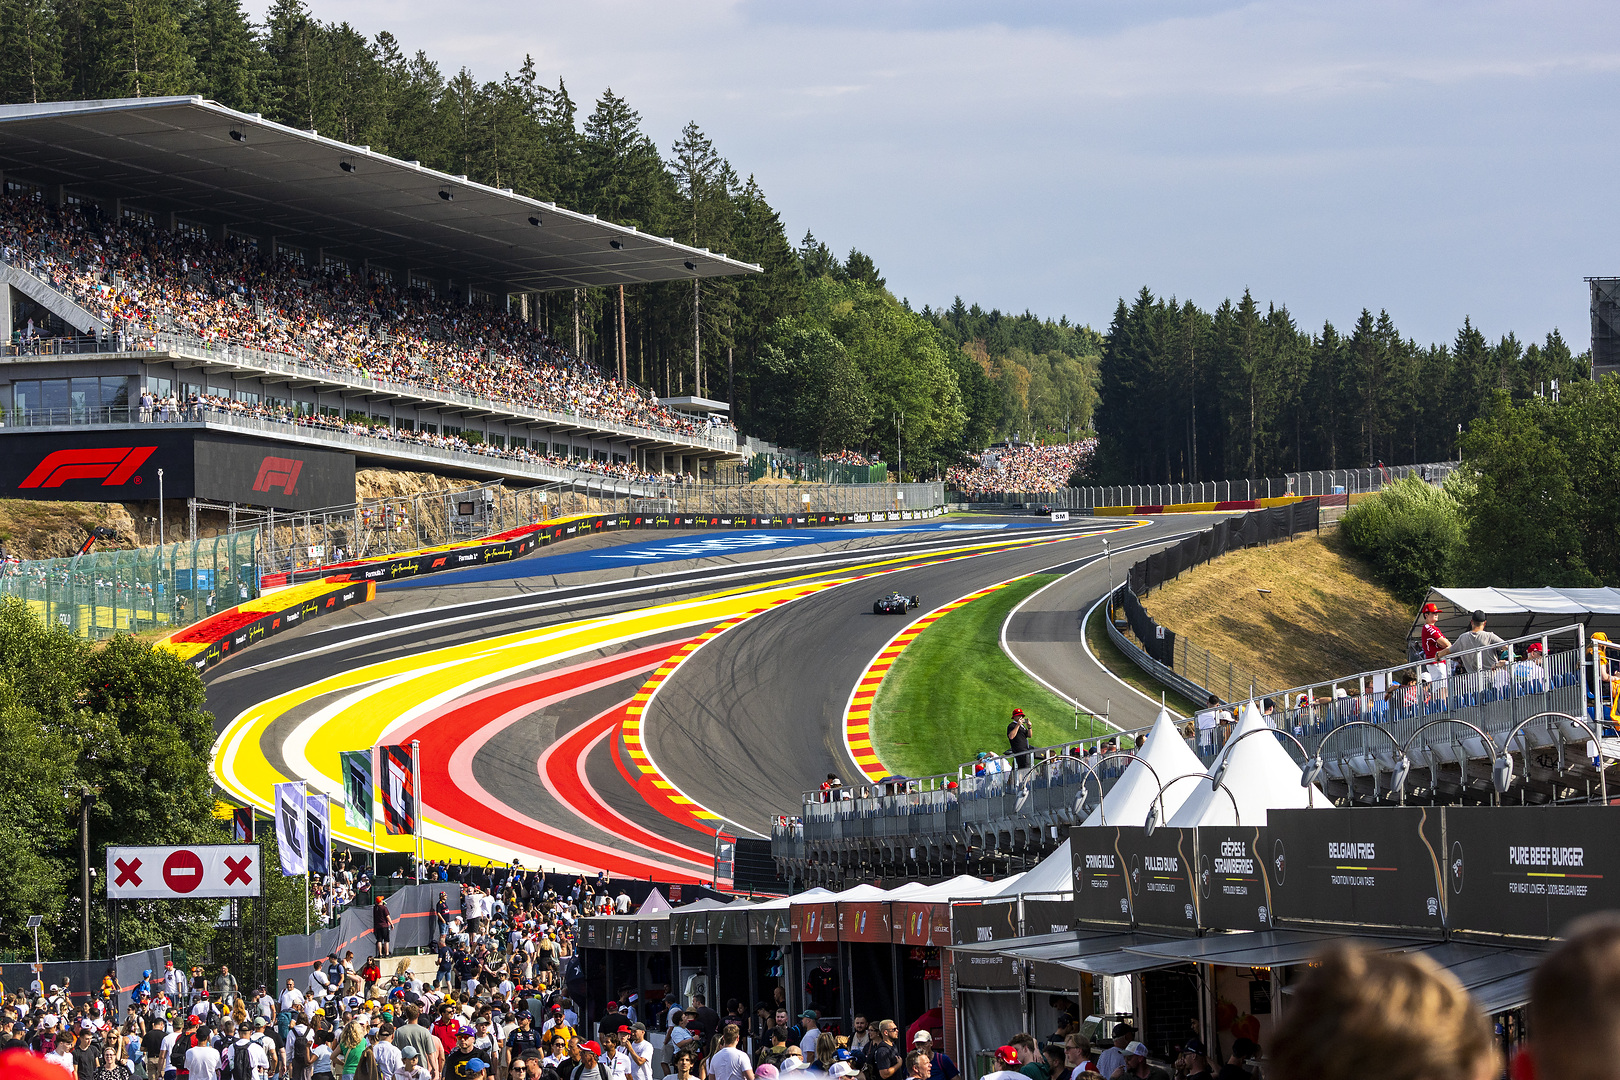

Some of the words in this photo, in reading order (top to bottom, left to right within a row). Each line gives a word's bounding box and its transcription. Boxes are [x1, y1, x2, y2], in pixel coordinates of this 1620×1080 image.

[18, 446, 158, 488] F1
[252, 456, 303, 496] F1
[1328, 842, 1357, 859] BELGIAN
[1357, 843, 1375, 860] FRIES
[1510, 846, 1530, 865] PURE
[1530, 846, 1551, 866] BEEF
[1551, 847, 1584, 867] BURGER
[1085, 854, 1101, 869] SPRING
[1102, 854, 1115, 869] ROLLS
[1144, 856, 1163, 871] PULLED
[1163, 857, 1179, 872] BUNS
[1214, 859, 1254, 874] STRAWBERRIES
[1509, 883, 1517, 893] FOR
[1518, 883, 1528, 893] MEAT
[1529, 884, 1545, 895] LOVERS
[1558, 885, 1576, 896] BELGIAN
[1576, 886, 1588, 896] BEEF
